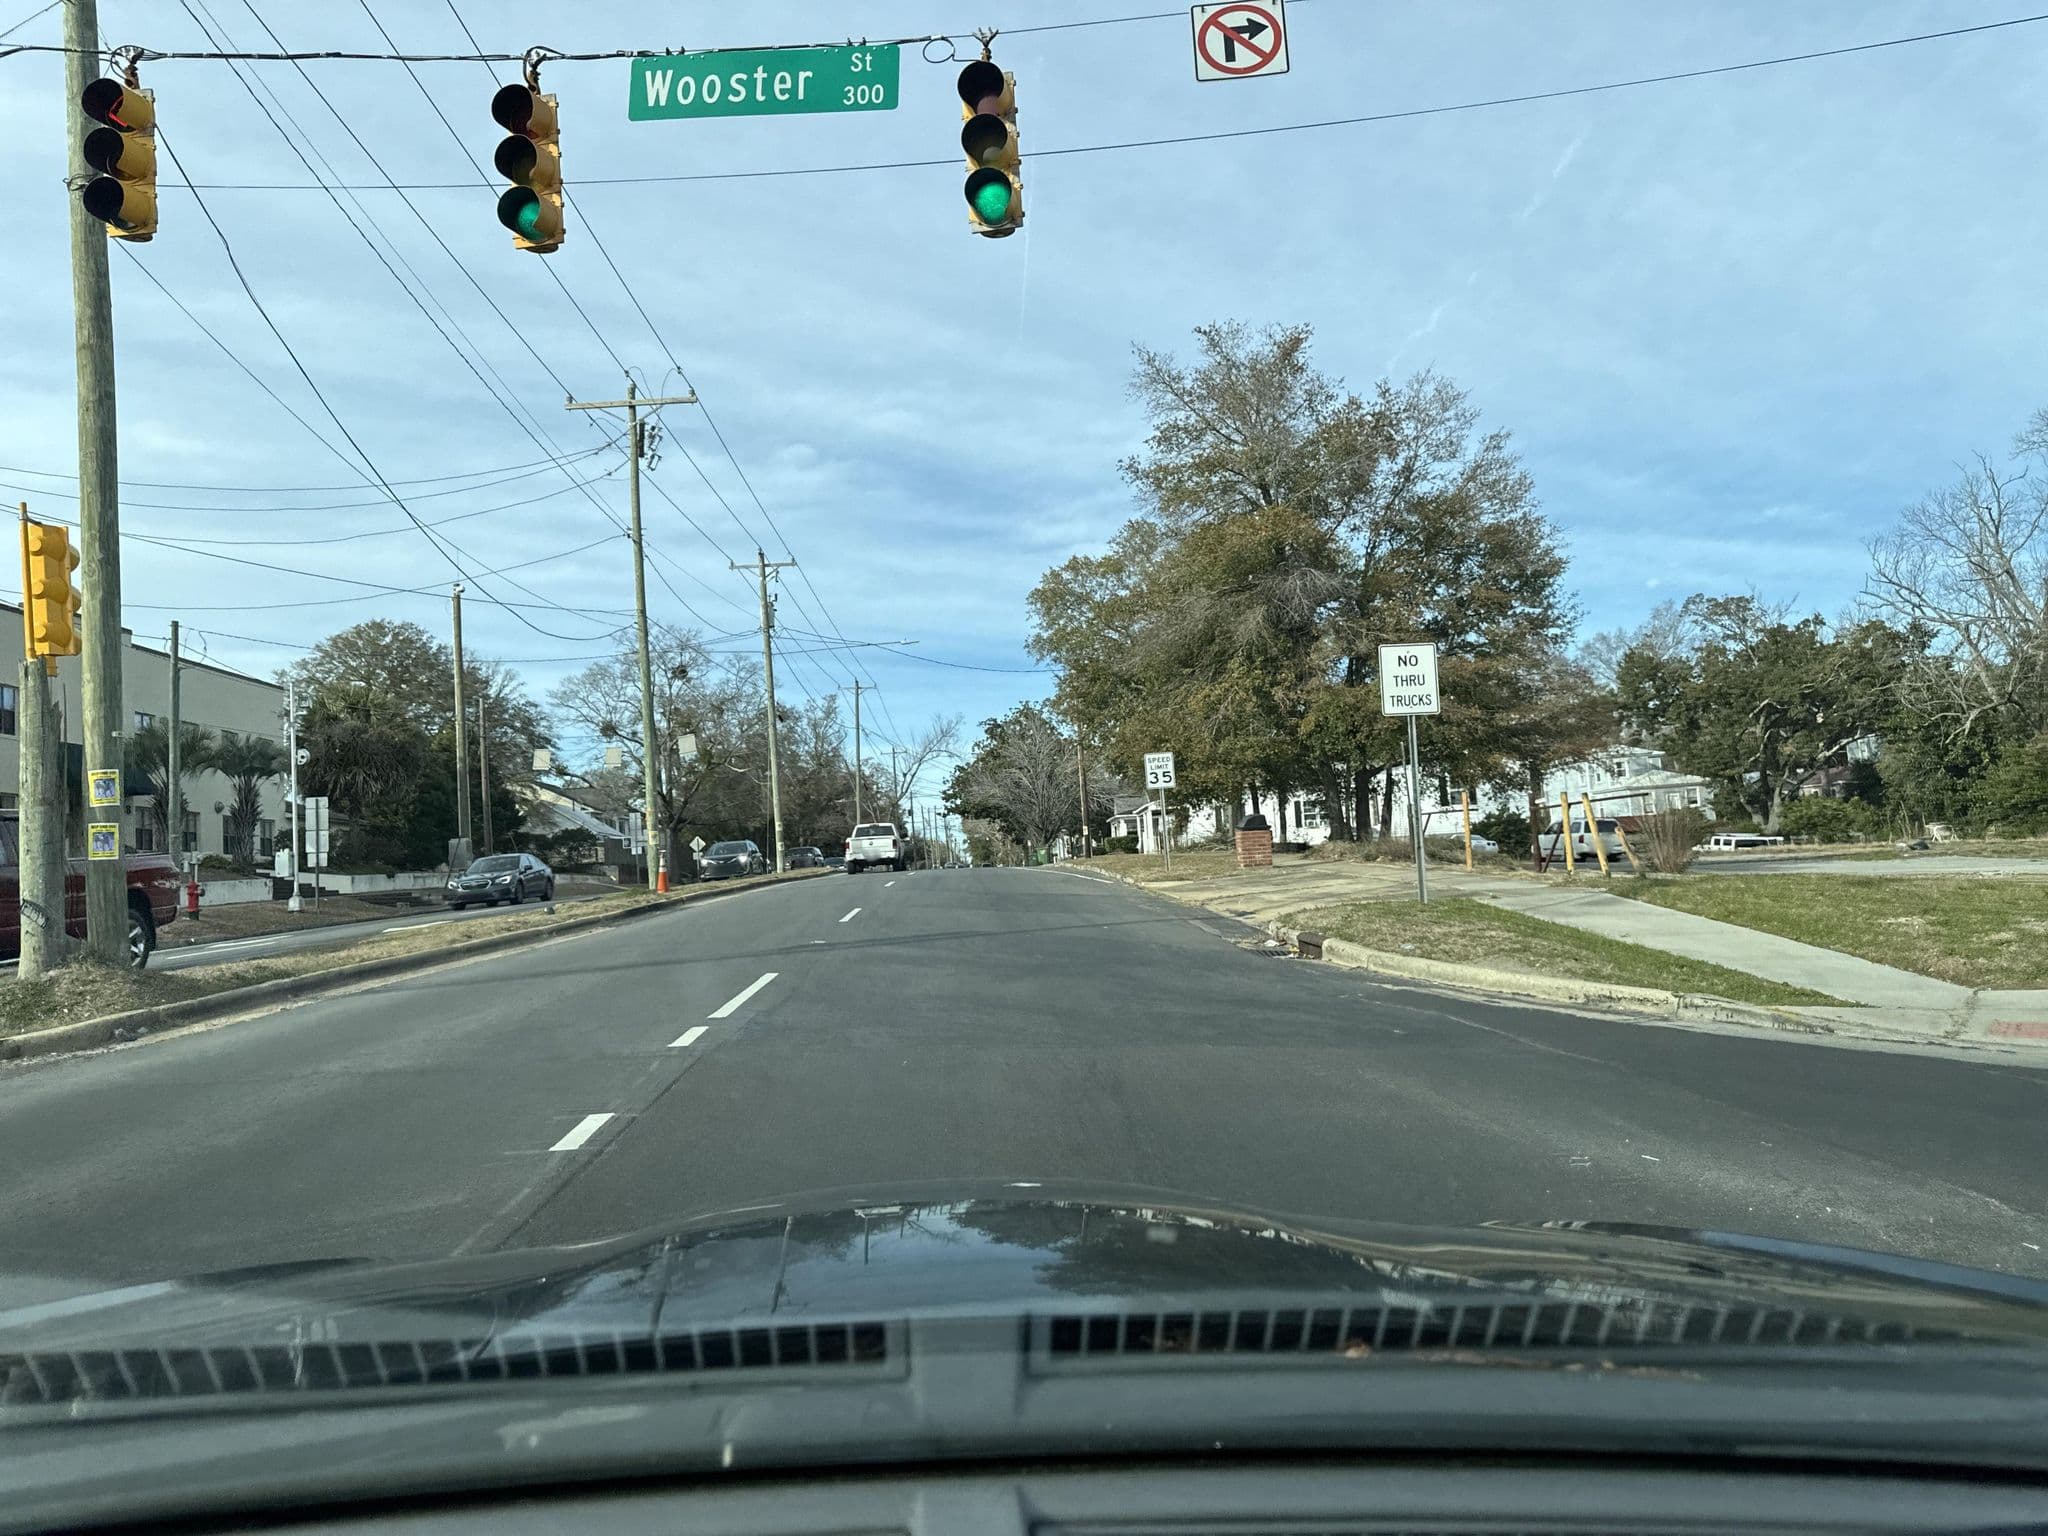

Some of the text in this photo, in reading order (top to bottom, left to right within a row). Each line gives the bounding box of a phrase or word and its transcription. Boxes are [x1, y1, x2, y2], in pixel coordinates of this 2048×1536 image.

[645, 52, 873, 107] Wooster St
[843, 84, 885, 106] 300
[1397, 654, 1419, 667] NO
[1393, 674, 1426, 687] THRU
[1389, 693, 1432, 707] TRUCKS
[1149, 771, 1173, 784] 35
